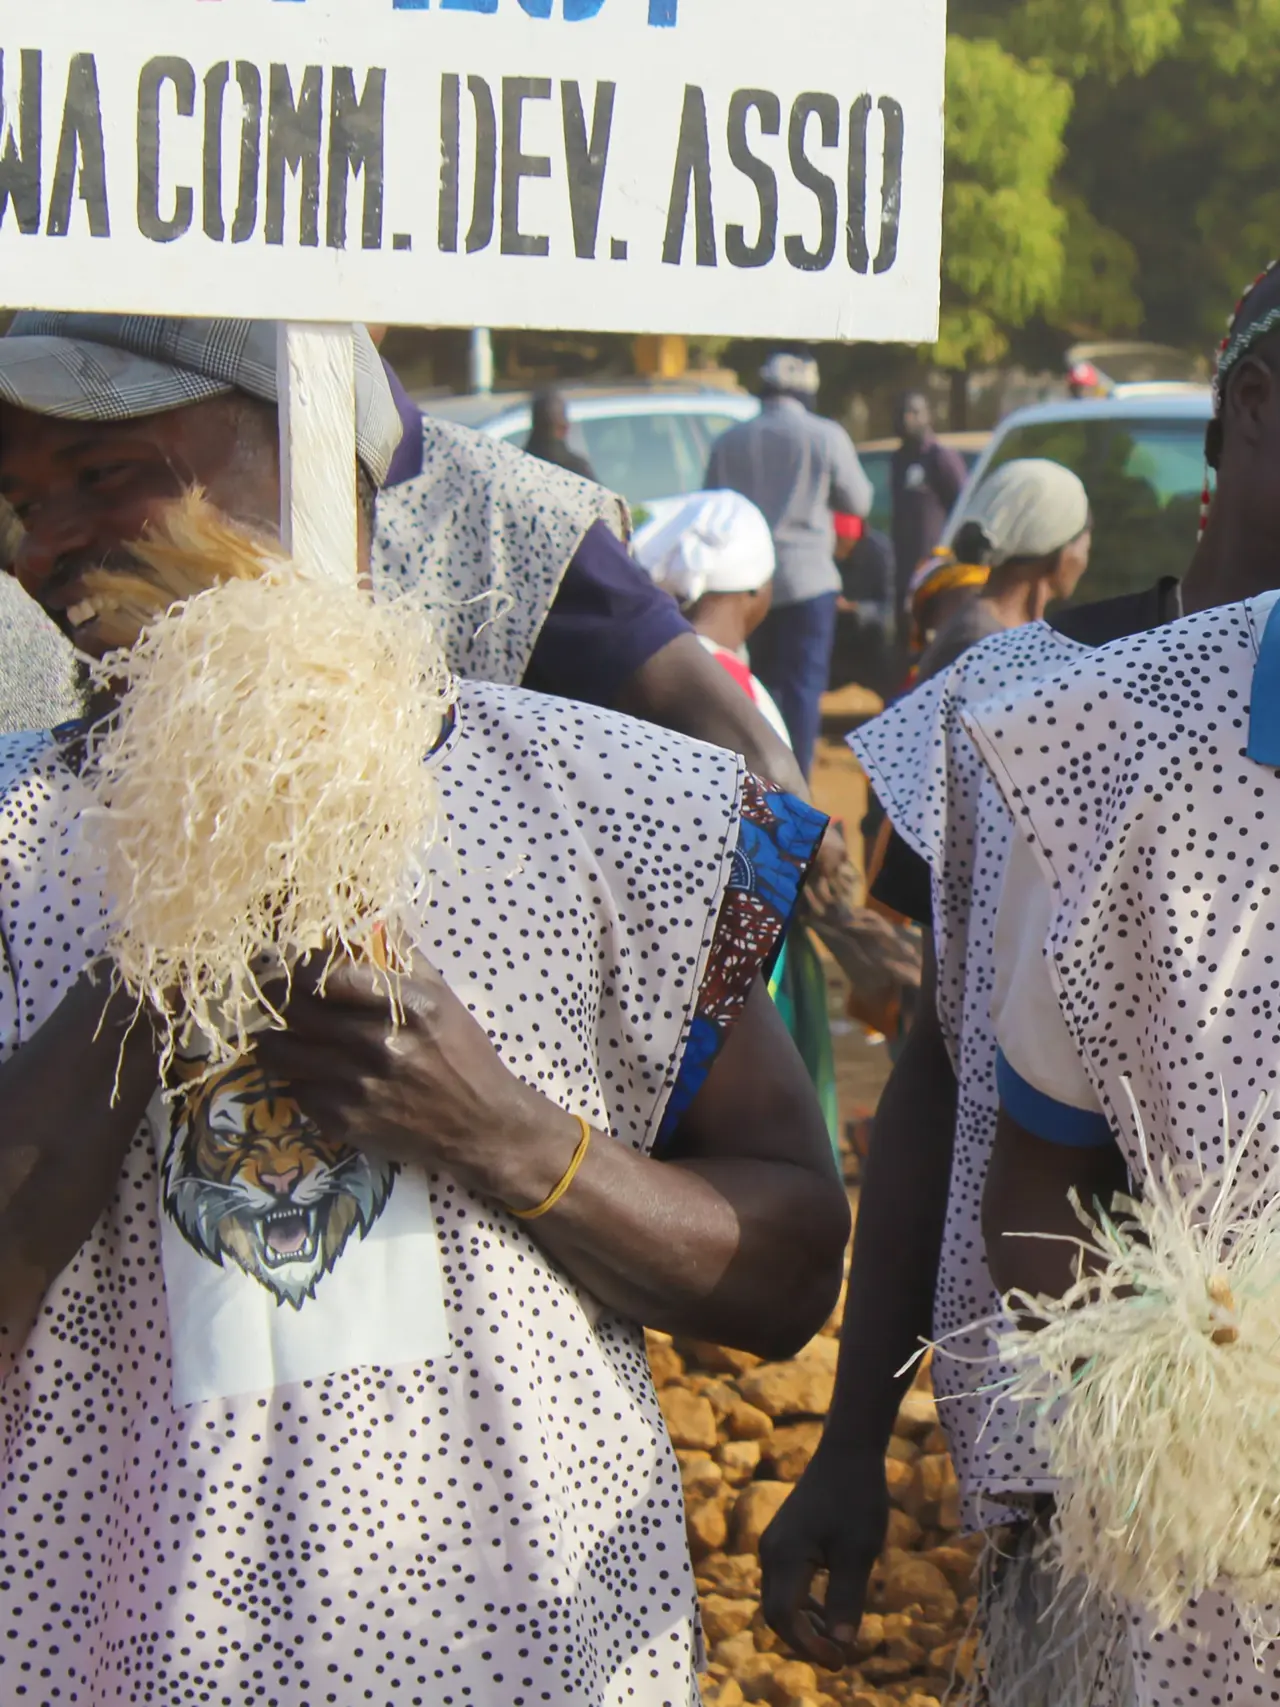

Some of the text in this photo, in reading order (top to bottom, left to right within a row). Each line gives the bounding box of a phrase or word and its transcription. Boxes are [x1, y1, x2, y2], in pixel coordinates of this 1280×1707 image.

[137, 56, 412, 251] COMM.
[438, 73, 628, 261] DEV.
[661, 84, 905, 275] ASSO
